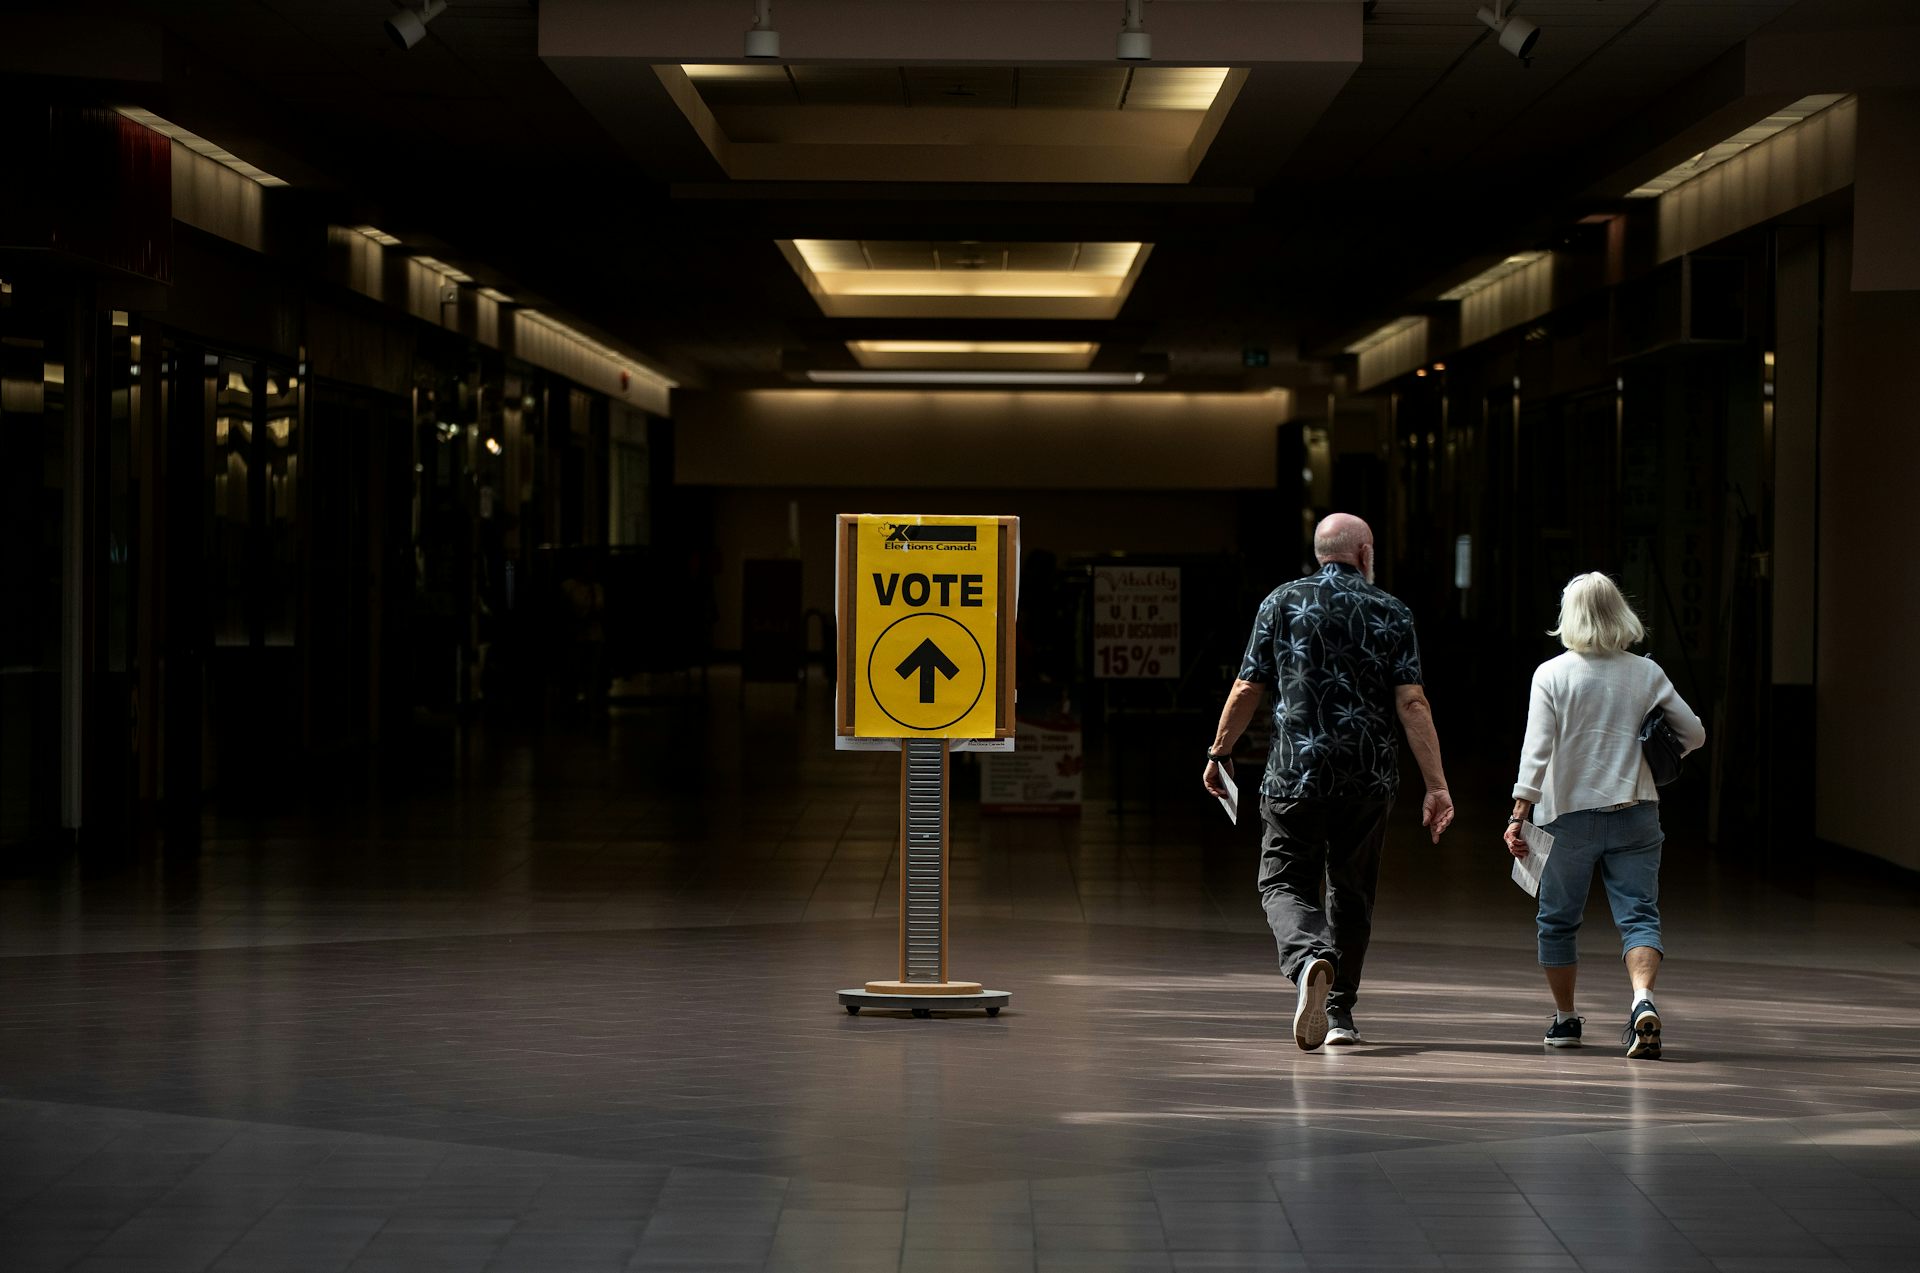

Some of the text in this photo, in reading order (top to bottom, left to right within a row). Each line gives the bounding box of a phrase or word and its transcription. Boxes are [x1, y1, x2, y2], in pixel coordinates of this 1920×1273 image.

[936, 542, 977, 552] Canada
[872, 573, 983, 607] VOTE
[1127, 623, 1177, 638] DISCOUNT
[1098, 646, 1160, 676] 15%
